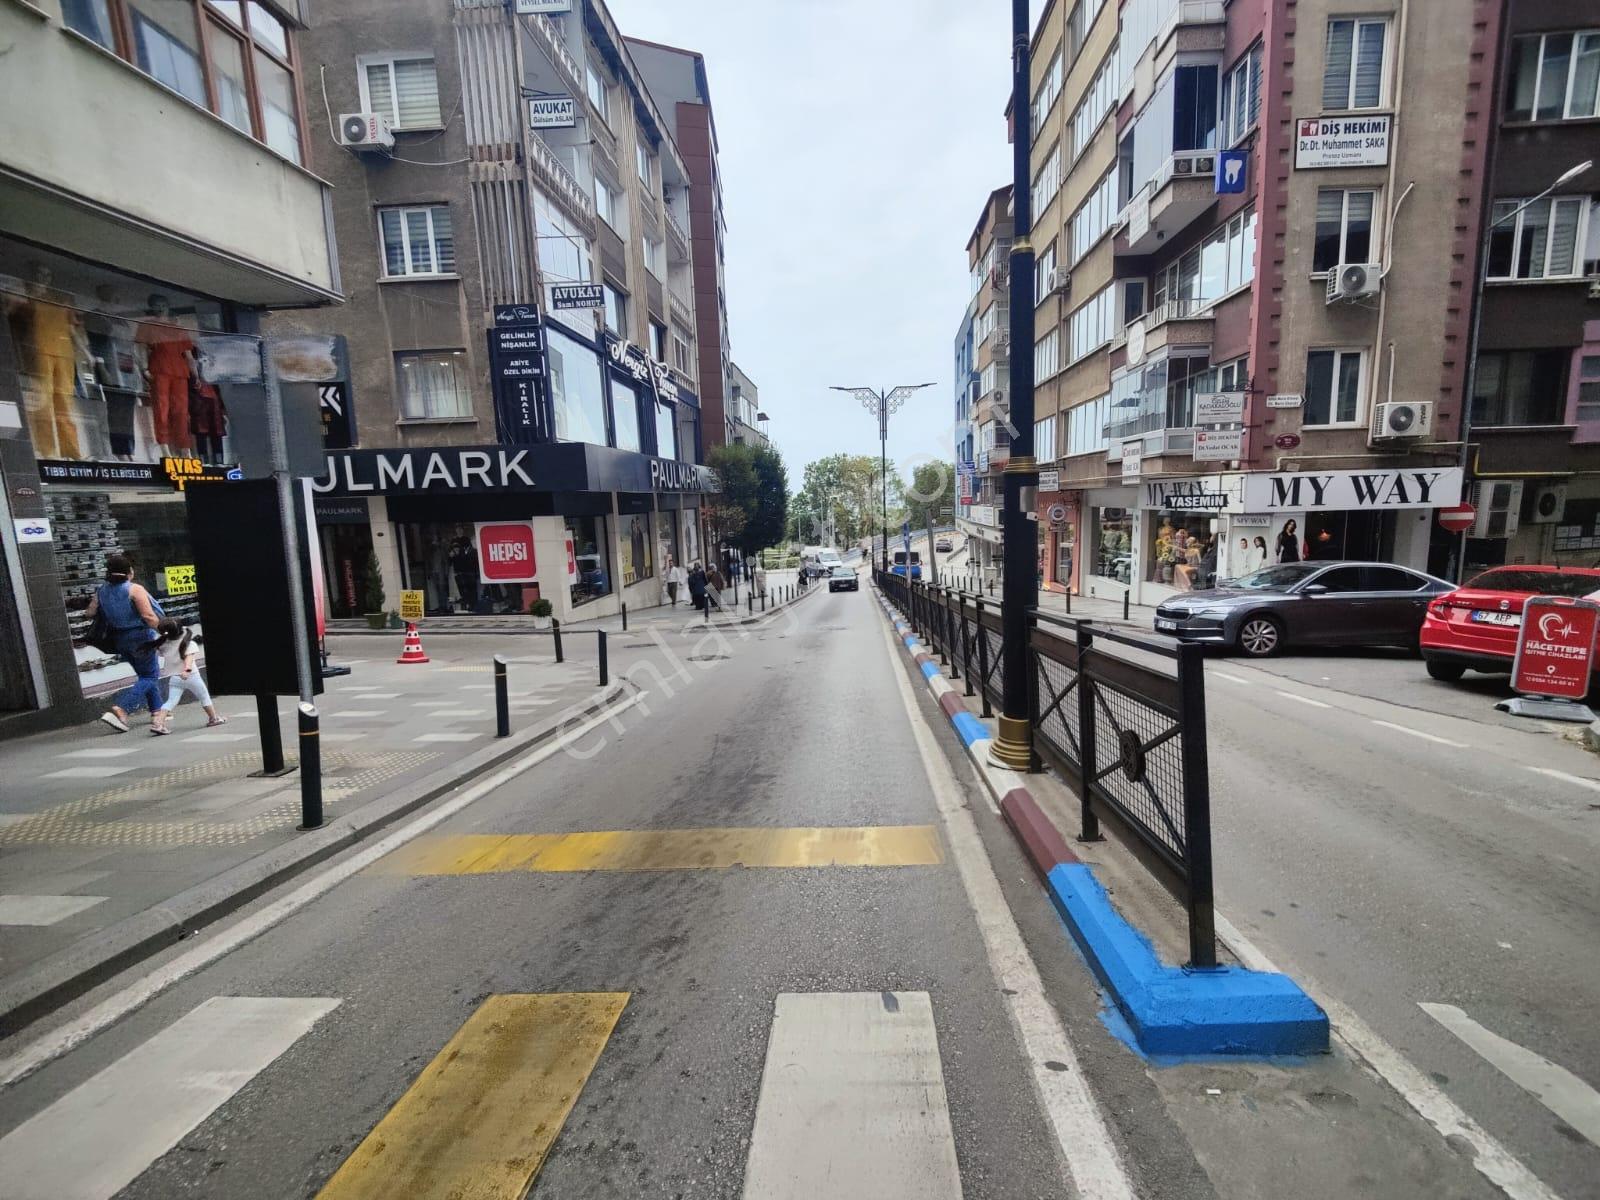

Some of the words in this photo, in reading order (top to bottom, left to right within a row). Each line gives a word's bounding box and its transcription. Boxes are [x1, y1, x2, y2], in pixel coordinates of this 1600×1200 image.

[533, 102, 571, 114] AVUKAT
[1321, 120, 1340, 137] DİŞ
[1344, 119, 1386, 134] HEKİMİ
[1322, 138, 1362, 149] Muhammet
[1365, 138, 1385, 148] SAKA
[554, 287, 601, 299] AVUKAT
[500, 332, 535, 340] GELİNLİK
[501, 341, 537, 349] NİŞANLIK
[611, 340, 649, 379] Nergiz
[312, 450, 536, 493] ULMARK
[1146, 482, 1168, 507] MY
[1268, 475, 1335, 507] MY
[1349, 472, 1441, 505] WAY
[316, 507, 364, 516] PAULMARK
